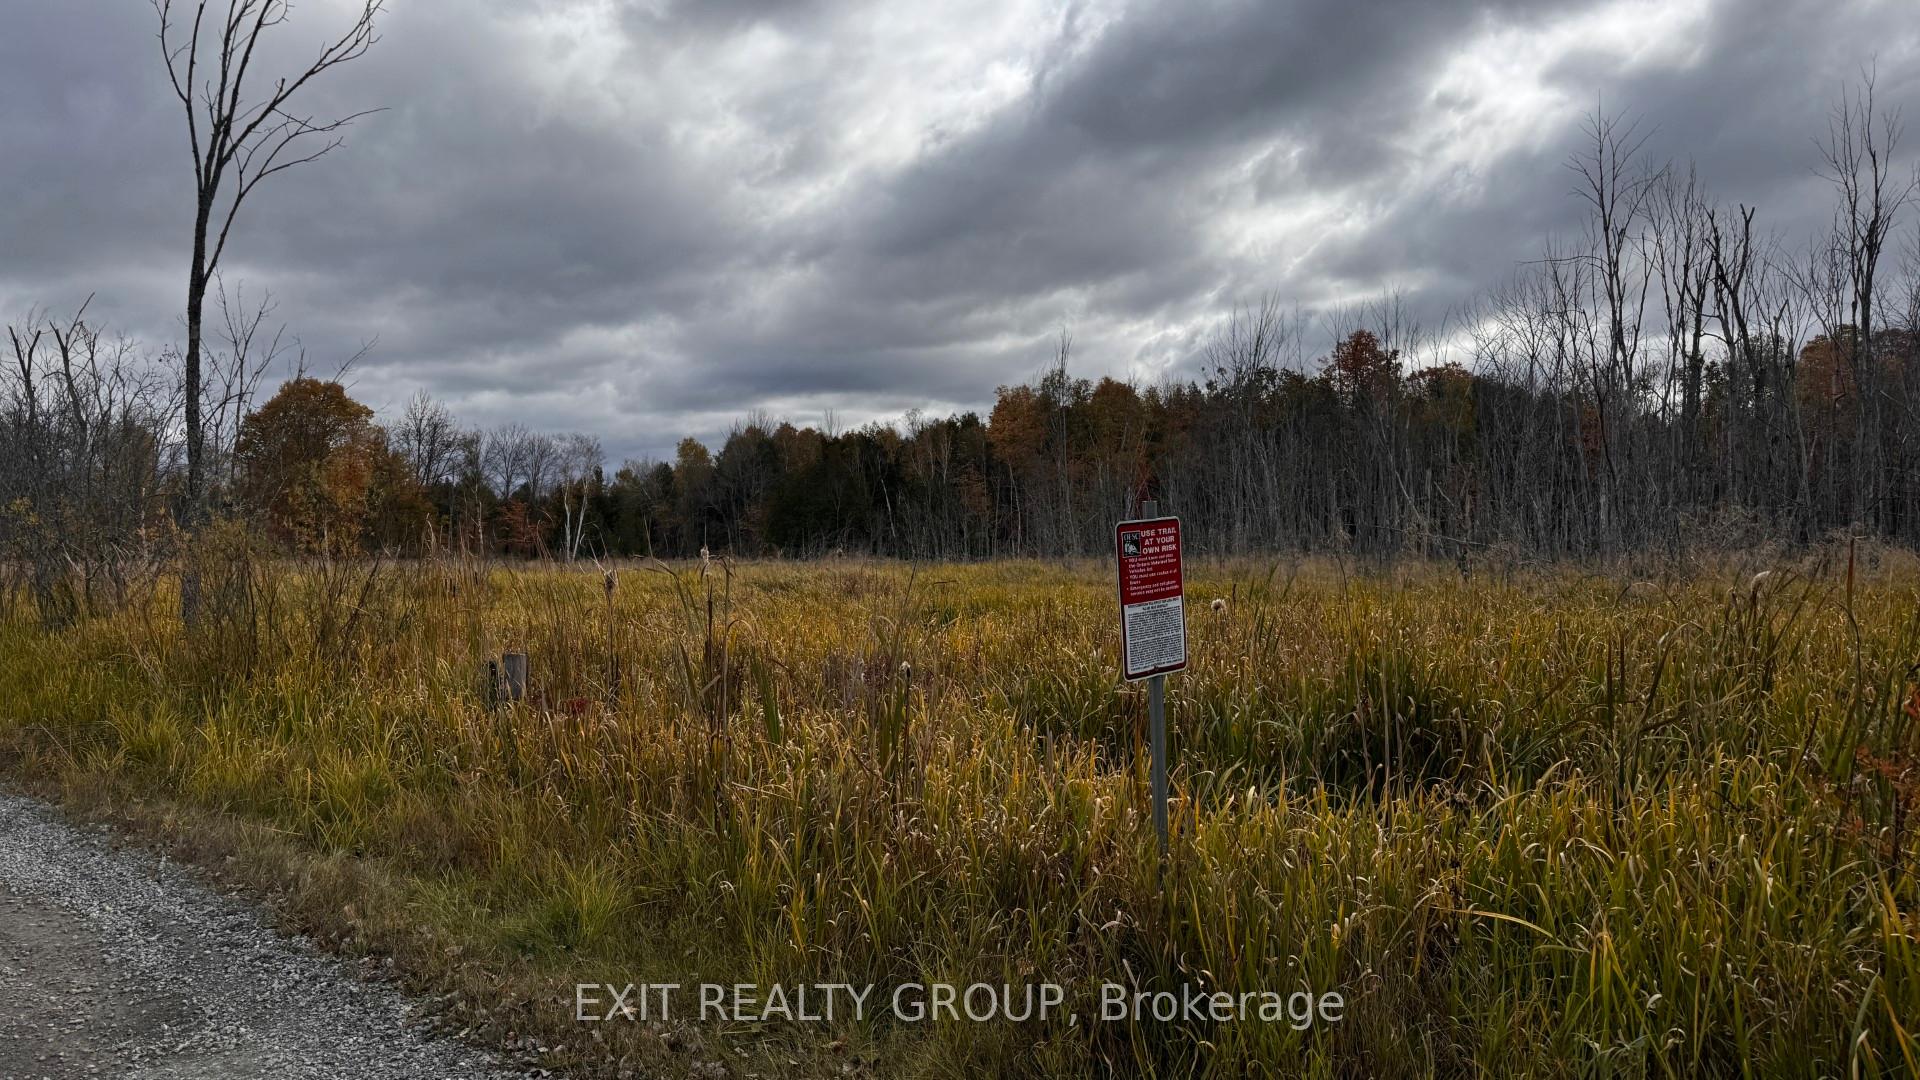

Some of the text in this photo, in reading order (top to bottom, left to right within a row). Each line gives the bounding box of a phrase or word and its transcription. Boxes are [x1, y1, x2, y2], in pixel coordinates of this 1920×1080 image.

[1156, 536, 1174, 544] YOUR
[1143, 544, 1176, 554] OWN RISK
